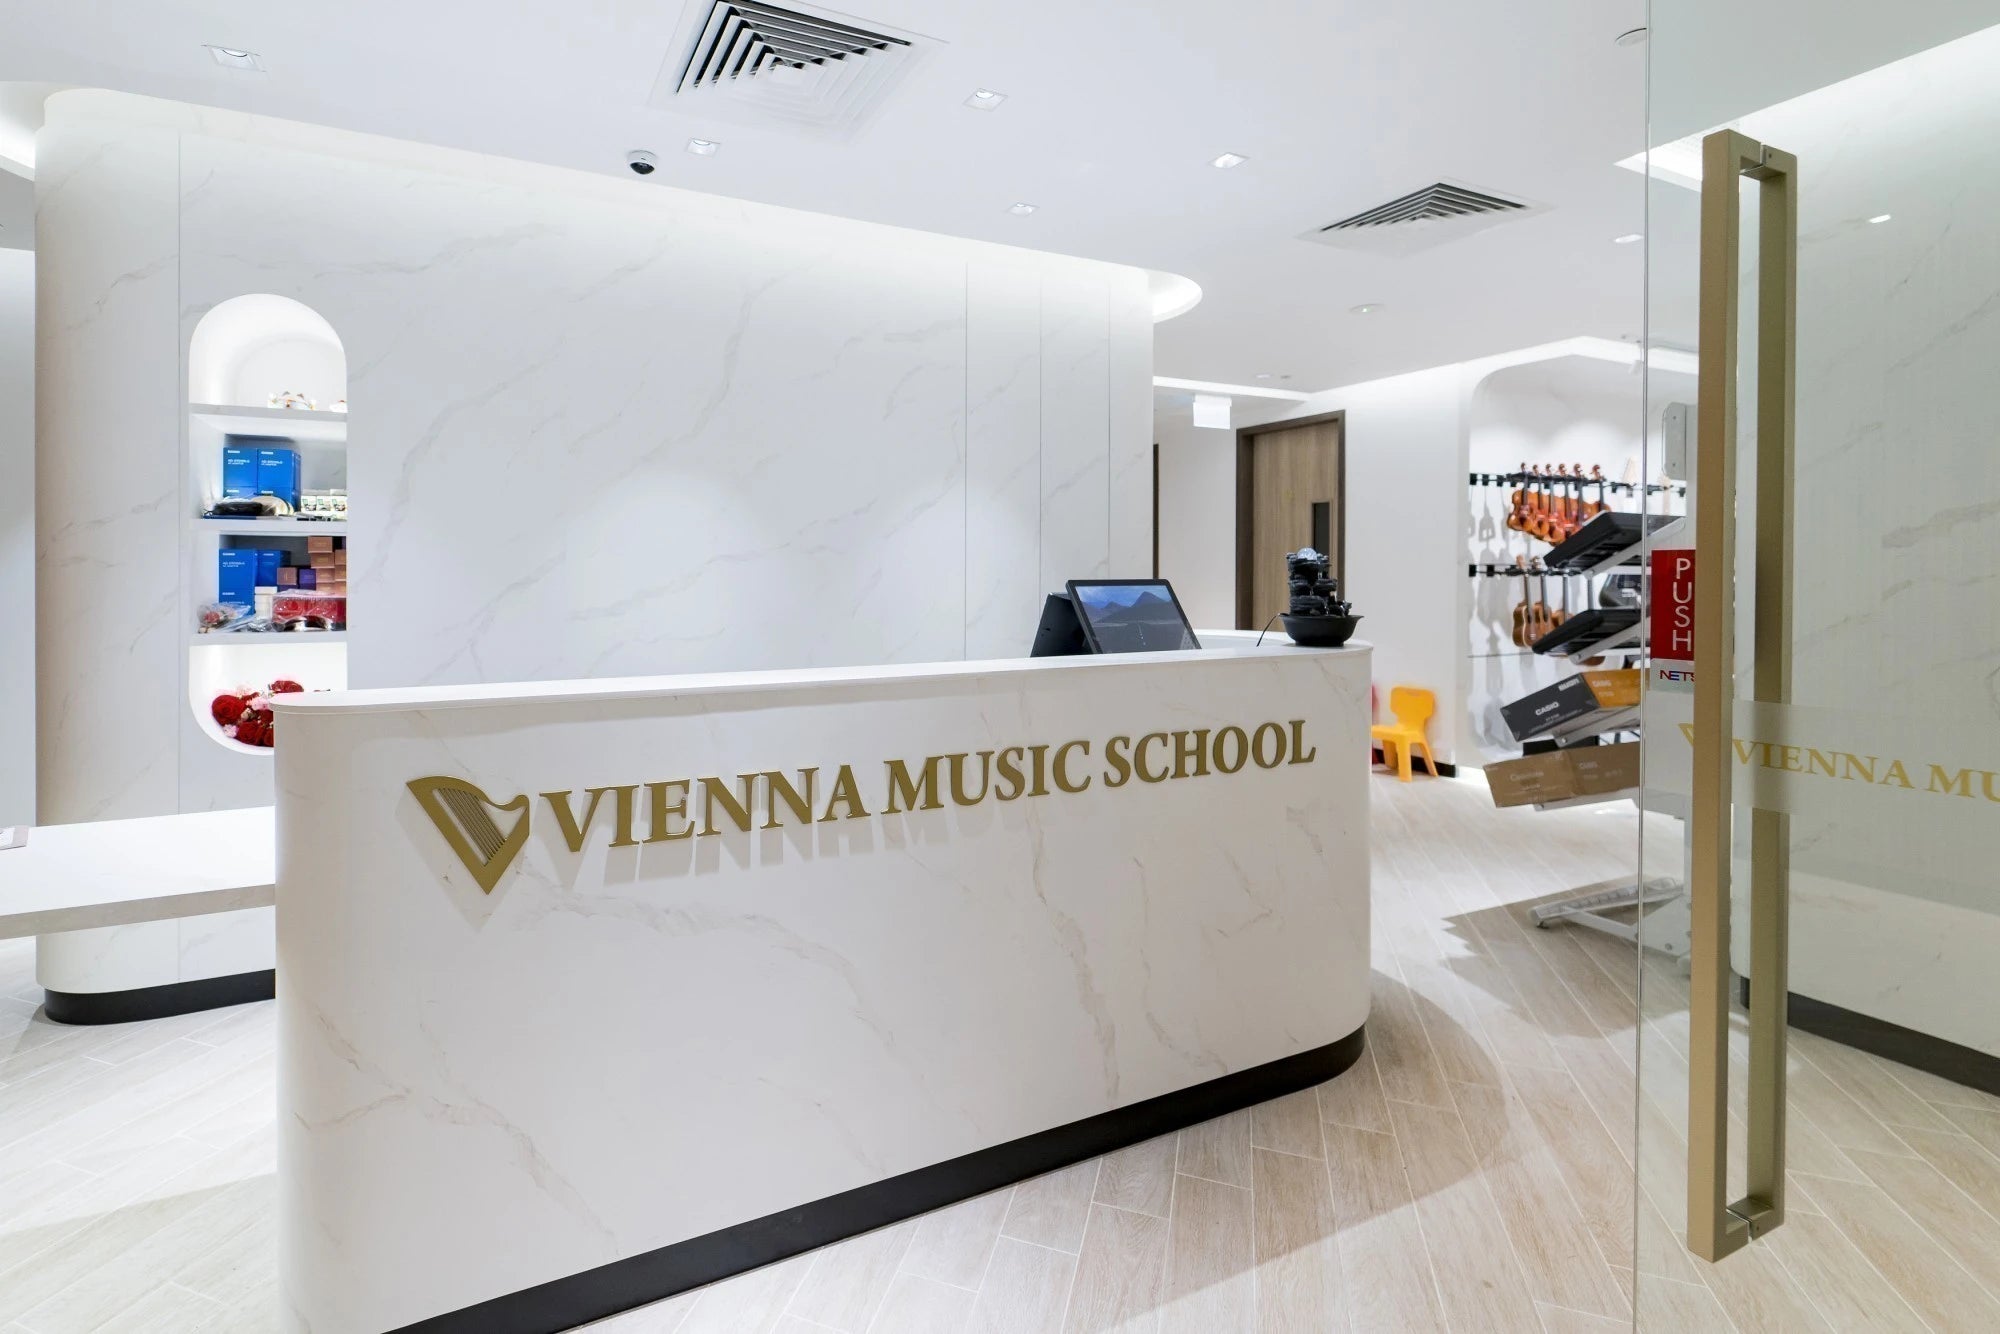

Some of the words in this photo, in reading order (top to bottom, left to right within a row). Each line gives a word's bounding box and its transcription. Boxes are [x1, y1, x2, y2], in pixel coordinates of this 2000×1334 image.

[1672, 557, 1692, 652] PUSH
[1535, 701, 1560, 716] CASIO
[538, 763, 872, 853] VIENNA
[880, 739, 1092, 815] MUSIC
[1103, 719, 1317, 788] SCHOOL
[1731, 738, 1916, 790] VIENNA
